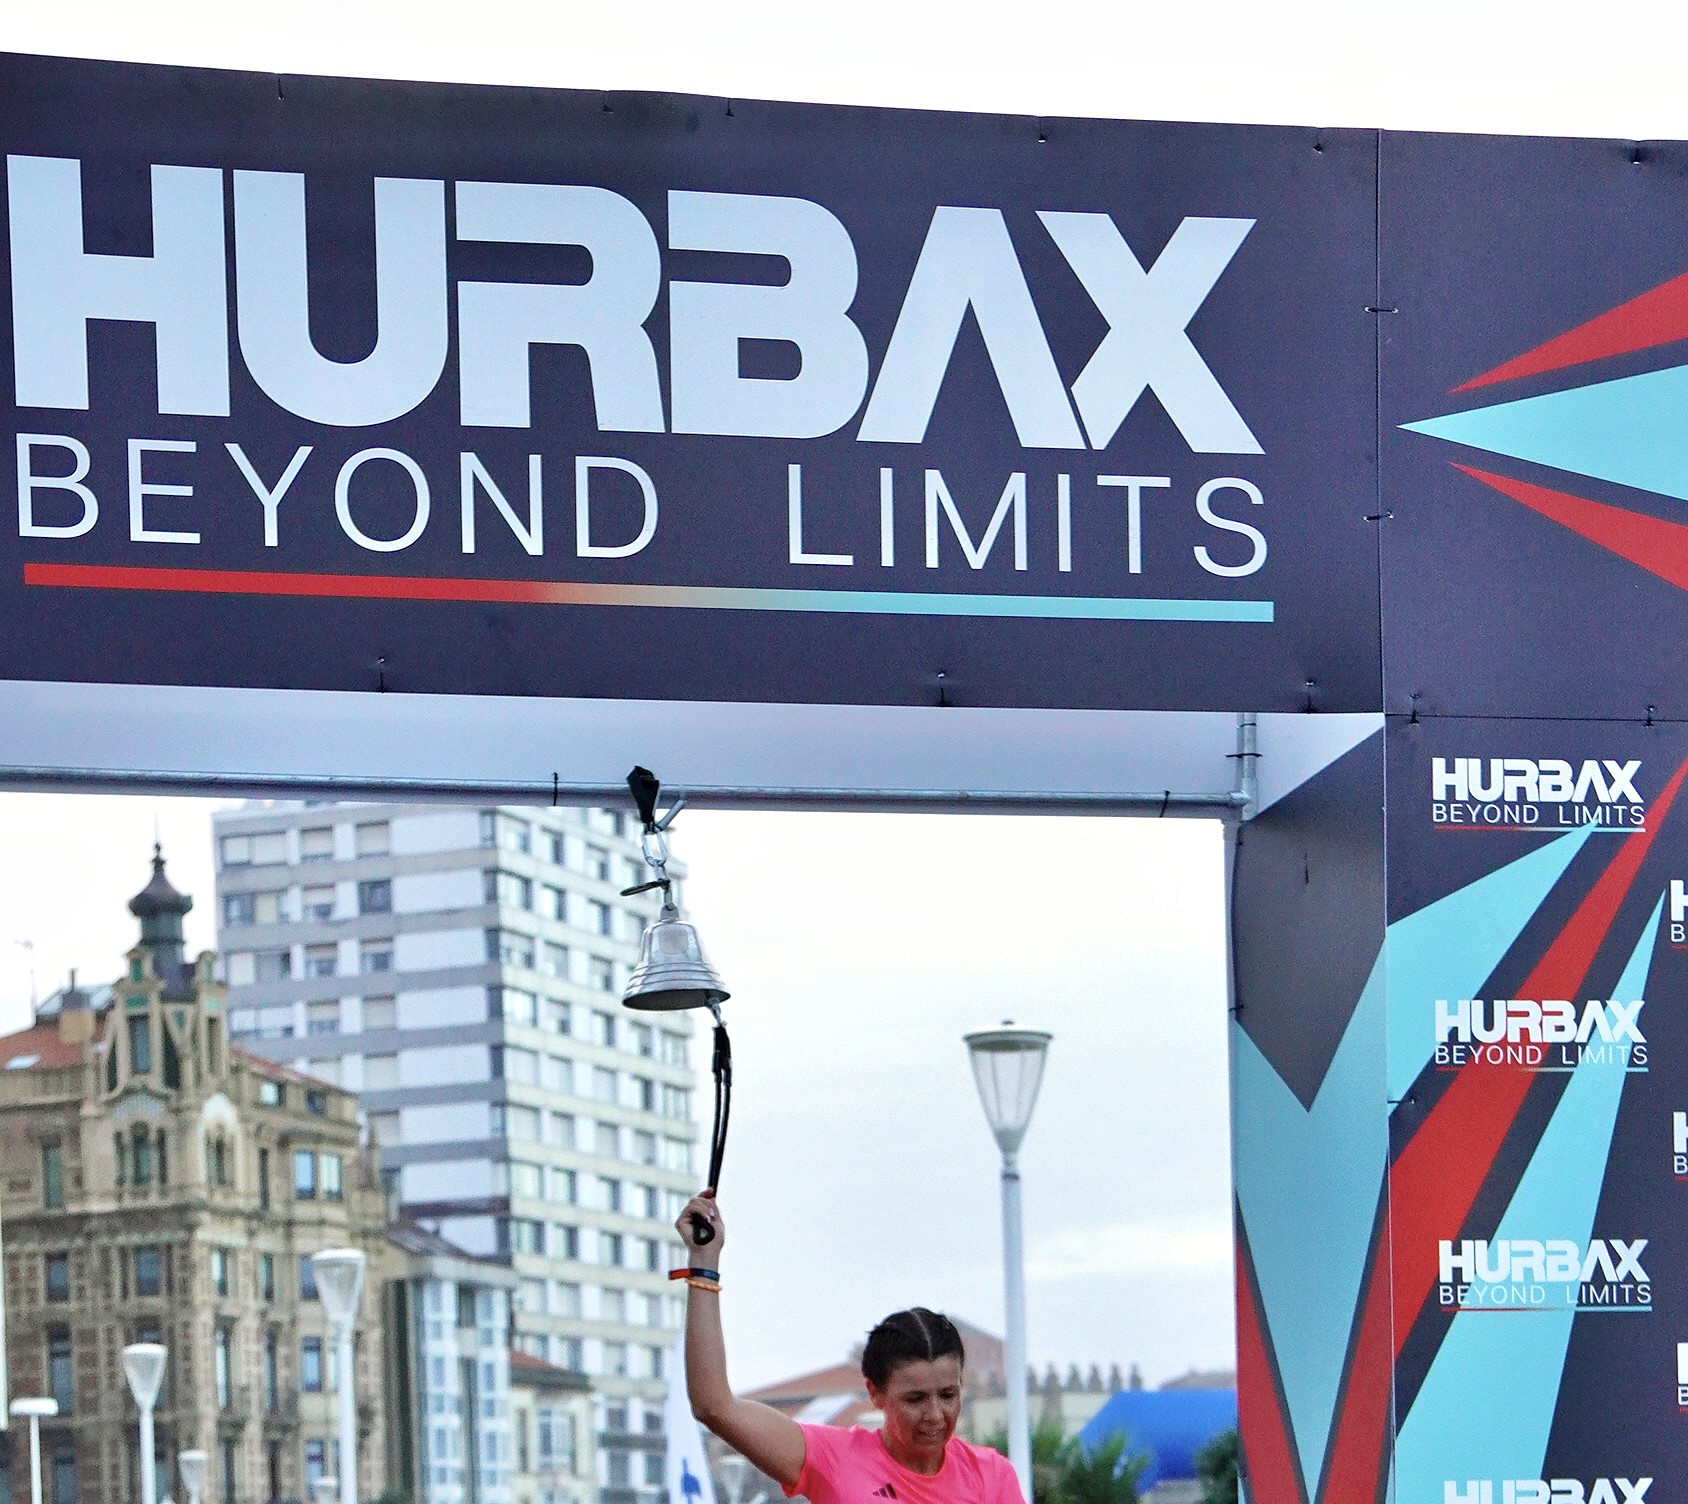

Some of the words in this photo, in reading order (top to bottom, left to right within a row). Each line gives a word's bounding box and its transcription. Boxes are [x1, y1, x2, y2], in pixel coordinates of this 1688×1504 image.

[6, 154, 1266, 455] HURBAX
[14, 432, 660, 559] BEYOND
[788, 463, 1269, 578] LIMITS
[1431, 757, 1645, 803] HURBAX
[1432, 803, 1540, 824] BEYOND
[1558, 804, 1646, 826] LIMITS
[1434, 999, 1648, 1044] HURBAX
[1435, 1044, 1543, 1066] BEYOND
[1561, 1045, 1649, 1066] LIMITS
[1437, 1239, 1650, 1284] HURBAX
[1439, 1284, 1546, 1305] BEYOND
[1565, 1284, 1652, 1305] LIMITS
